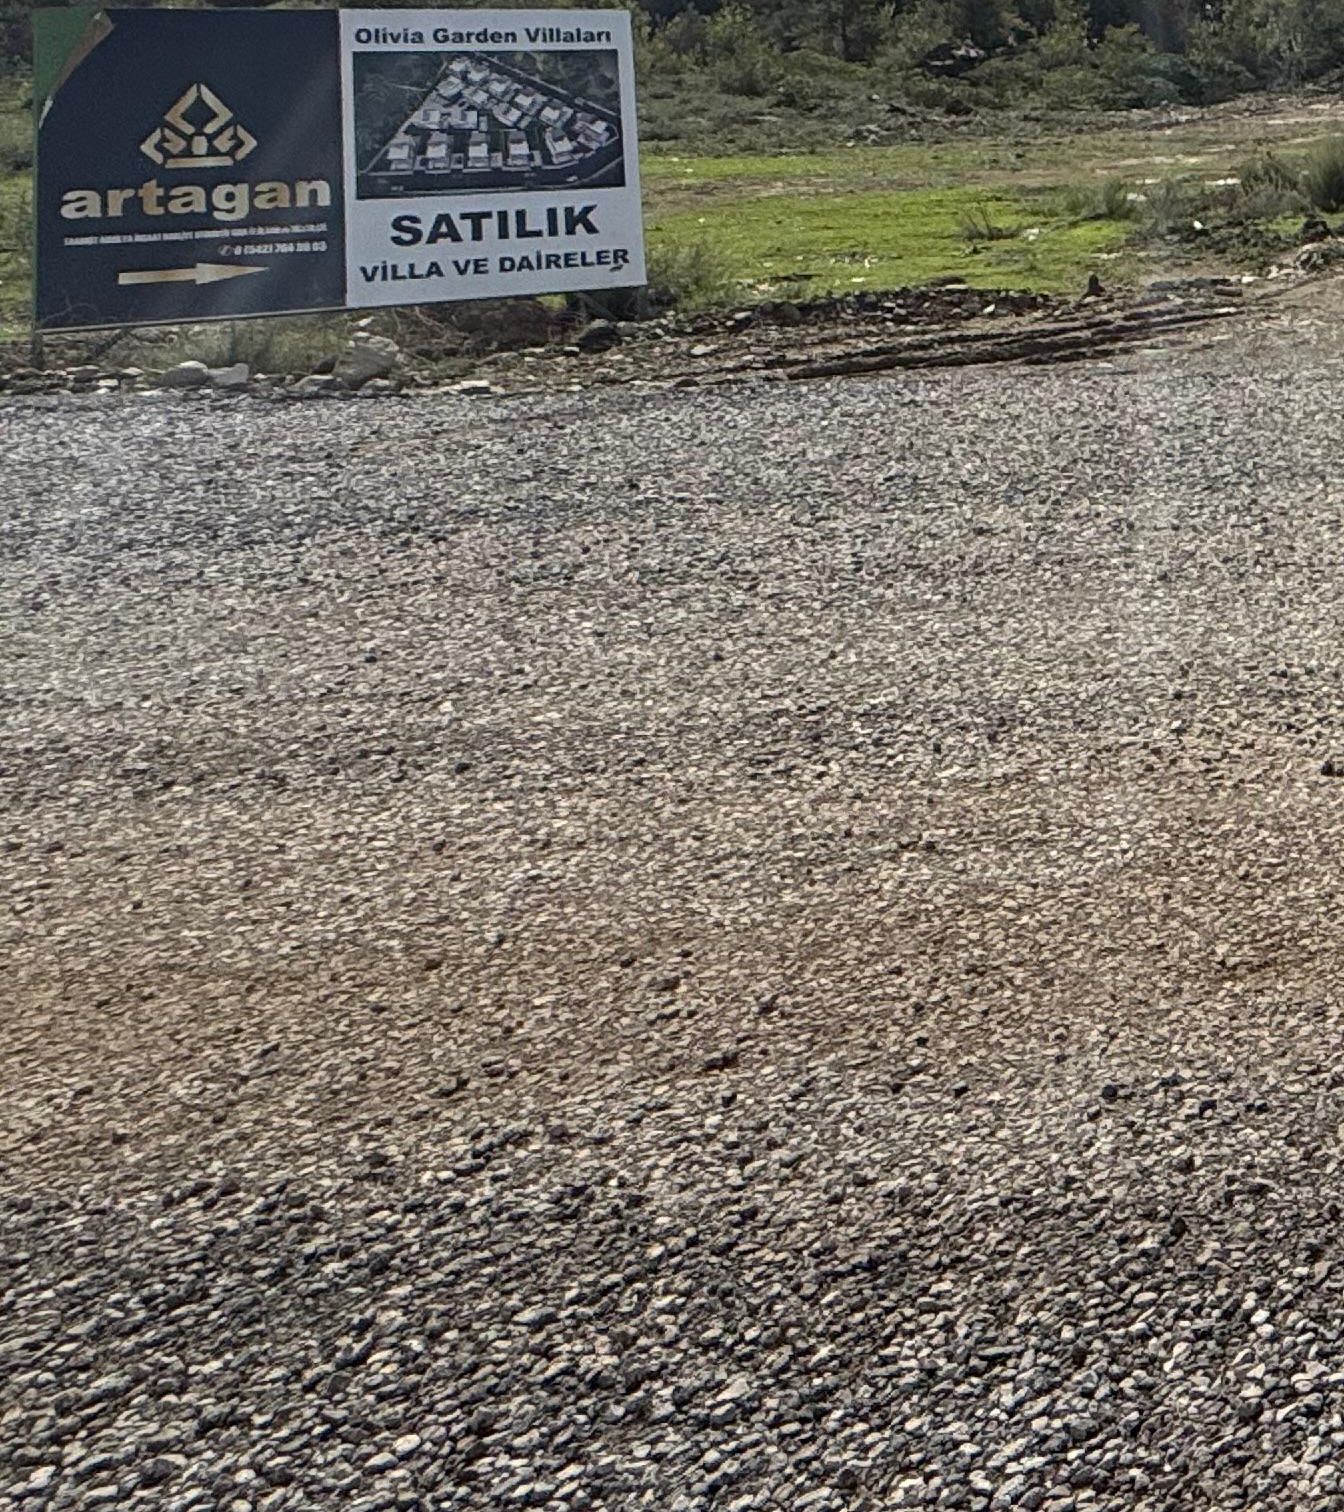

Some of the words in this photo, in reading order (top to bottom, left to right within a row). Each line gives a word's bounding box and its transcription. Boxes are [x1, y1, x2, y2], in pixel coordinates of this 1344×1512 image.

[355, 27, 425, 44] Olivia
[432, 27, 518, 44] Garden
[524, 26, 612, 44] Villaları
[60, 178, 331, 221] artagan
[390, 204, 600, 247] SATILIK
[360, 260, 444, 282] VİLLA
[453, 257, 490, 276] VE
[499, 248, 630, 273] DAİRELER
